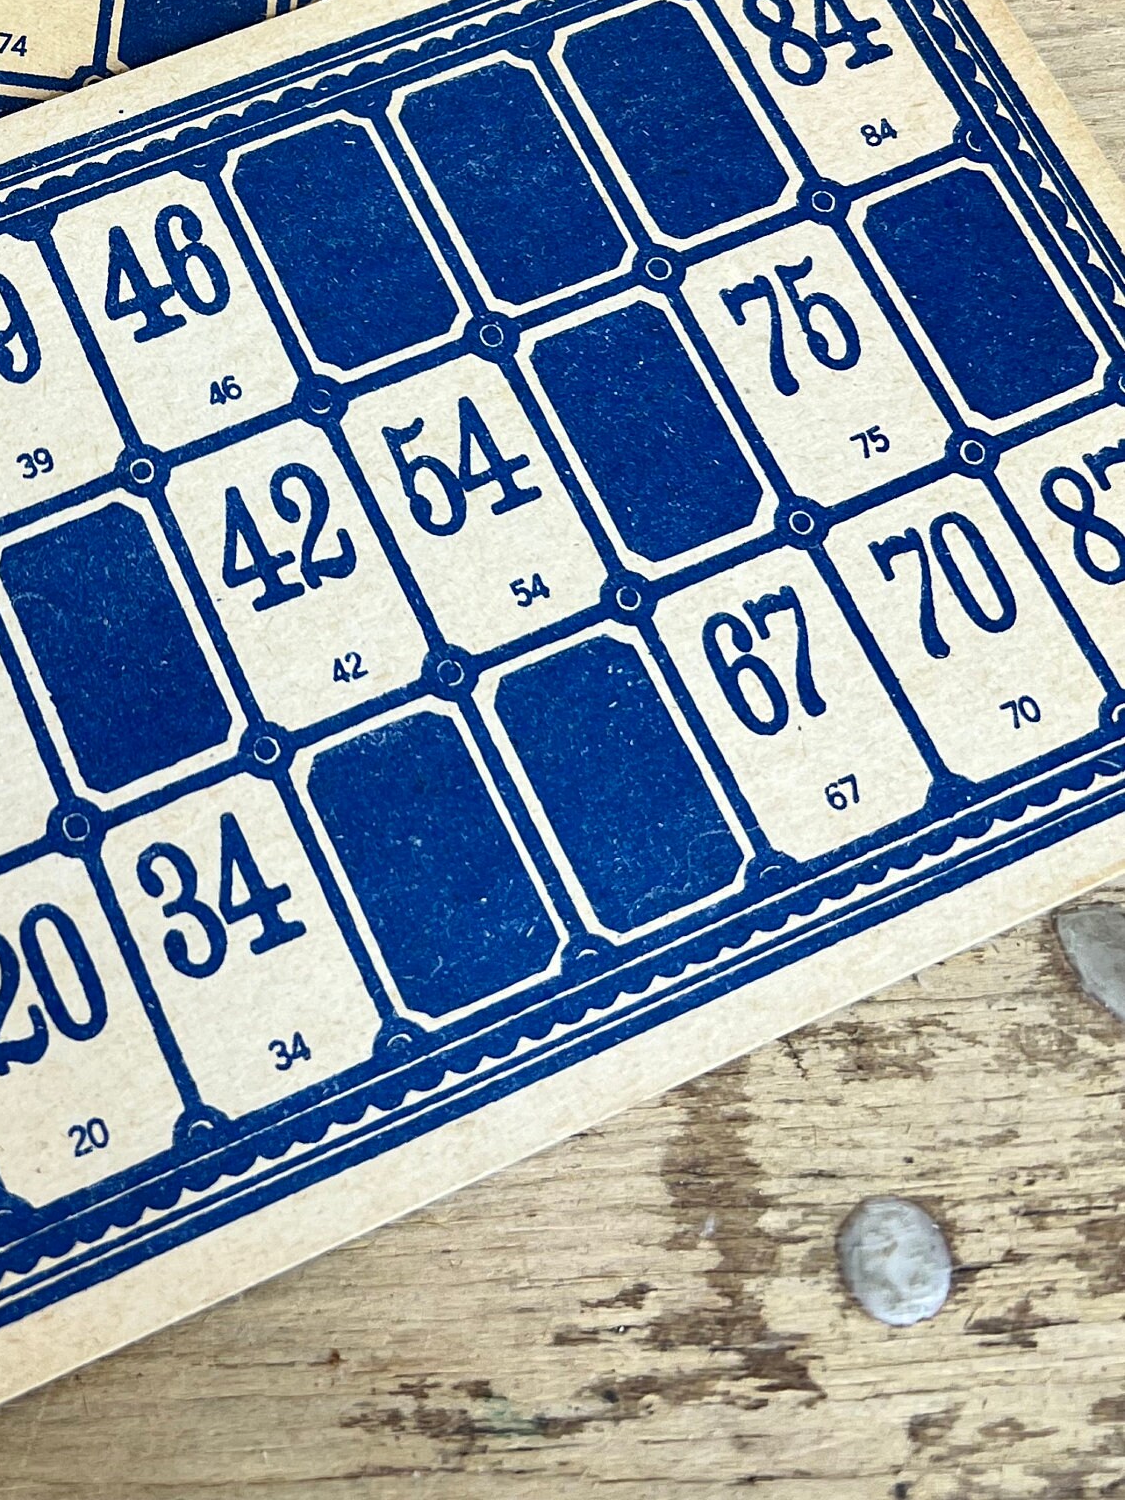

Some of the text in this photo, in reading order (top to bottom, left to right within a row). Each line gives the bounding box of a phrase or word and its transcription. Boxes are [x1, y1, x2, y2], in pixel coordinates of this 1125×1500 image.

[17, 448, 53, 479] 39
[210, 376, 242, 405] 46
[861, 118, 897, 147] 84
[105, 204, 230, 343] 46
[222, 463, 357, 612] 42
[381, 396, 542, 536] 54
[719, 256, 861, 396] 75
[333, 652, 368, 682] 42
[509, 573, 550, 607] 54
[850, 426, 889, 458] 75
[136, 812, 306, 979] 34
[702, 586, 826, 735] 67
[868, 512, 1017, 659] 70
[68, 1118, 109, 1157] 20
[268, 1032, 311, 1071] 34
[825, 774, 859, 810] 67
[1000, 695, 1041, 729] 70
